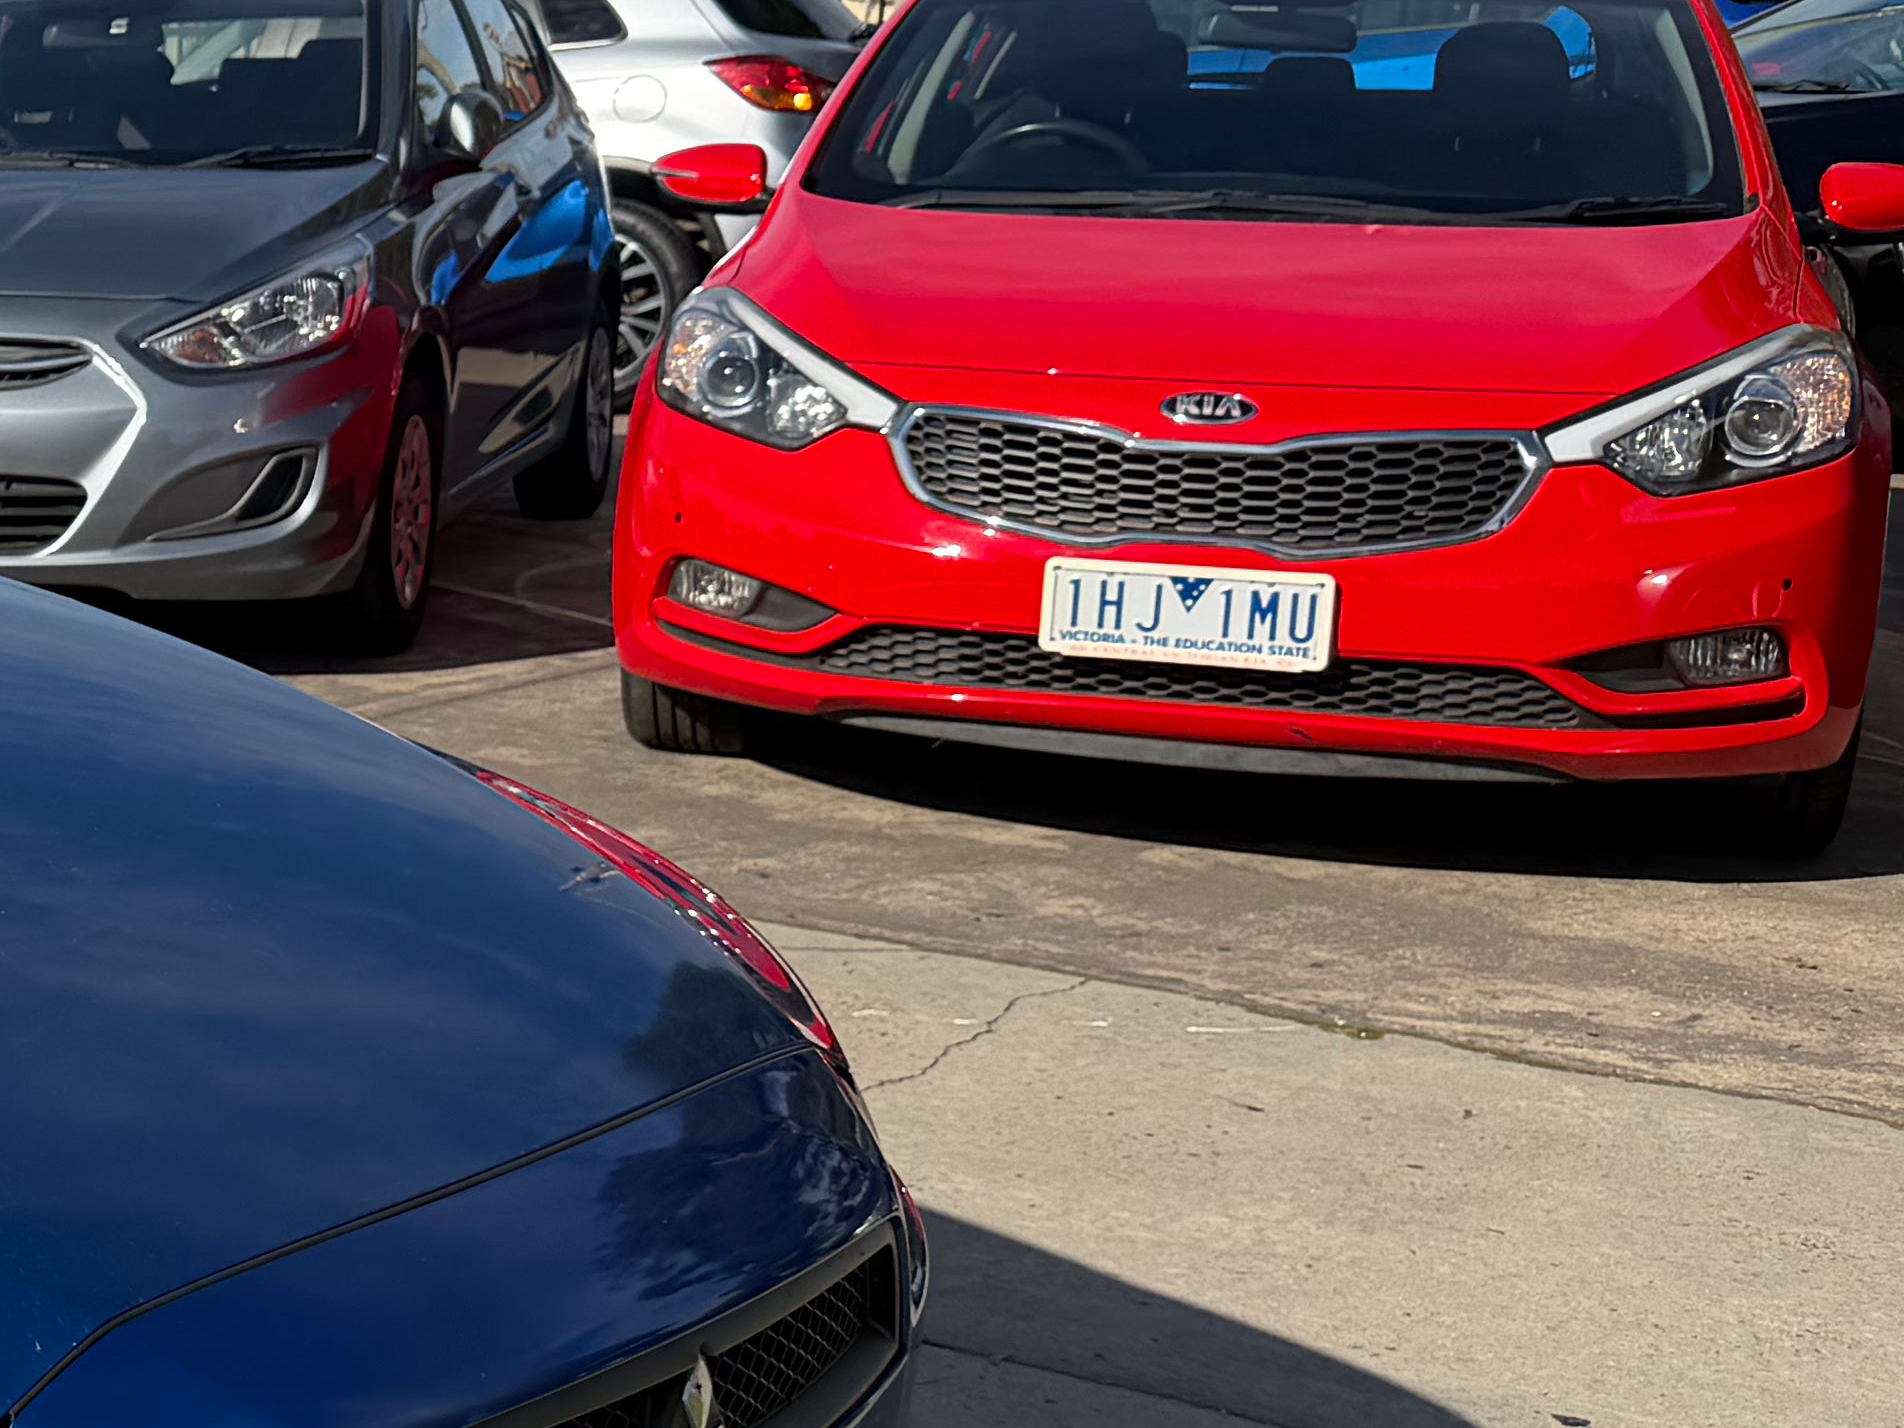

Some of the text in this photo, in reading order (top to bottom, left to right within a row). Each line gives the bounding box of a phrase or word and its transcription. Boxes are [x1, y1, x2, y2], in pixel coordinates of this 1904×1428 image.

[1175, 393, 1242, 418] KIA
[1068, 578, 1318, 644] 1HJ 1MU
[1059, 629, 1126, 644] VICTORIA
[1143, 635, 1169, 647] THE
[1174, 637, 1263, 655] EDUCATION
[1267, 644, 1311, 659] STATE
